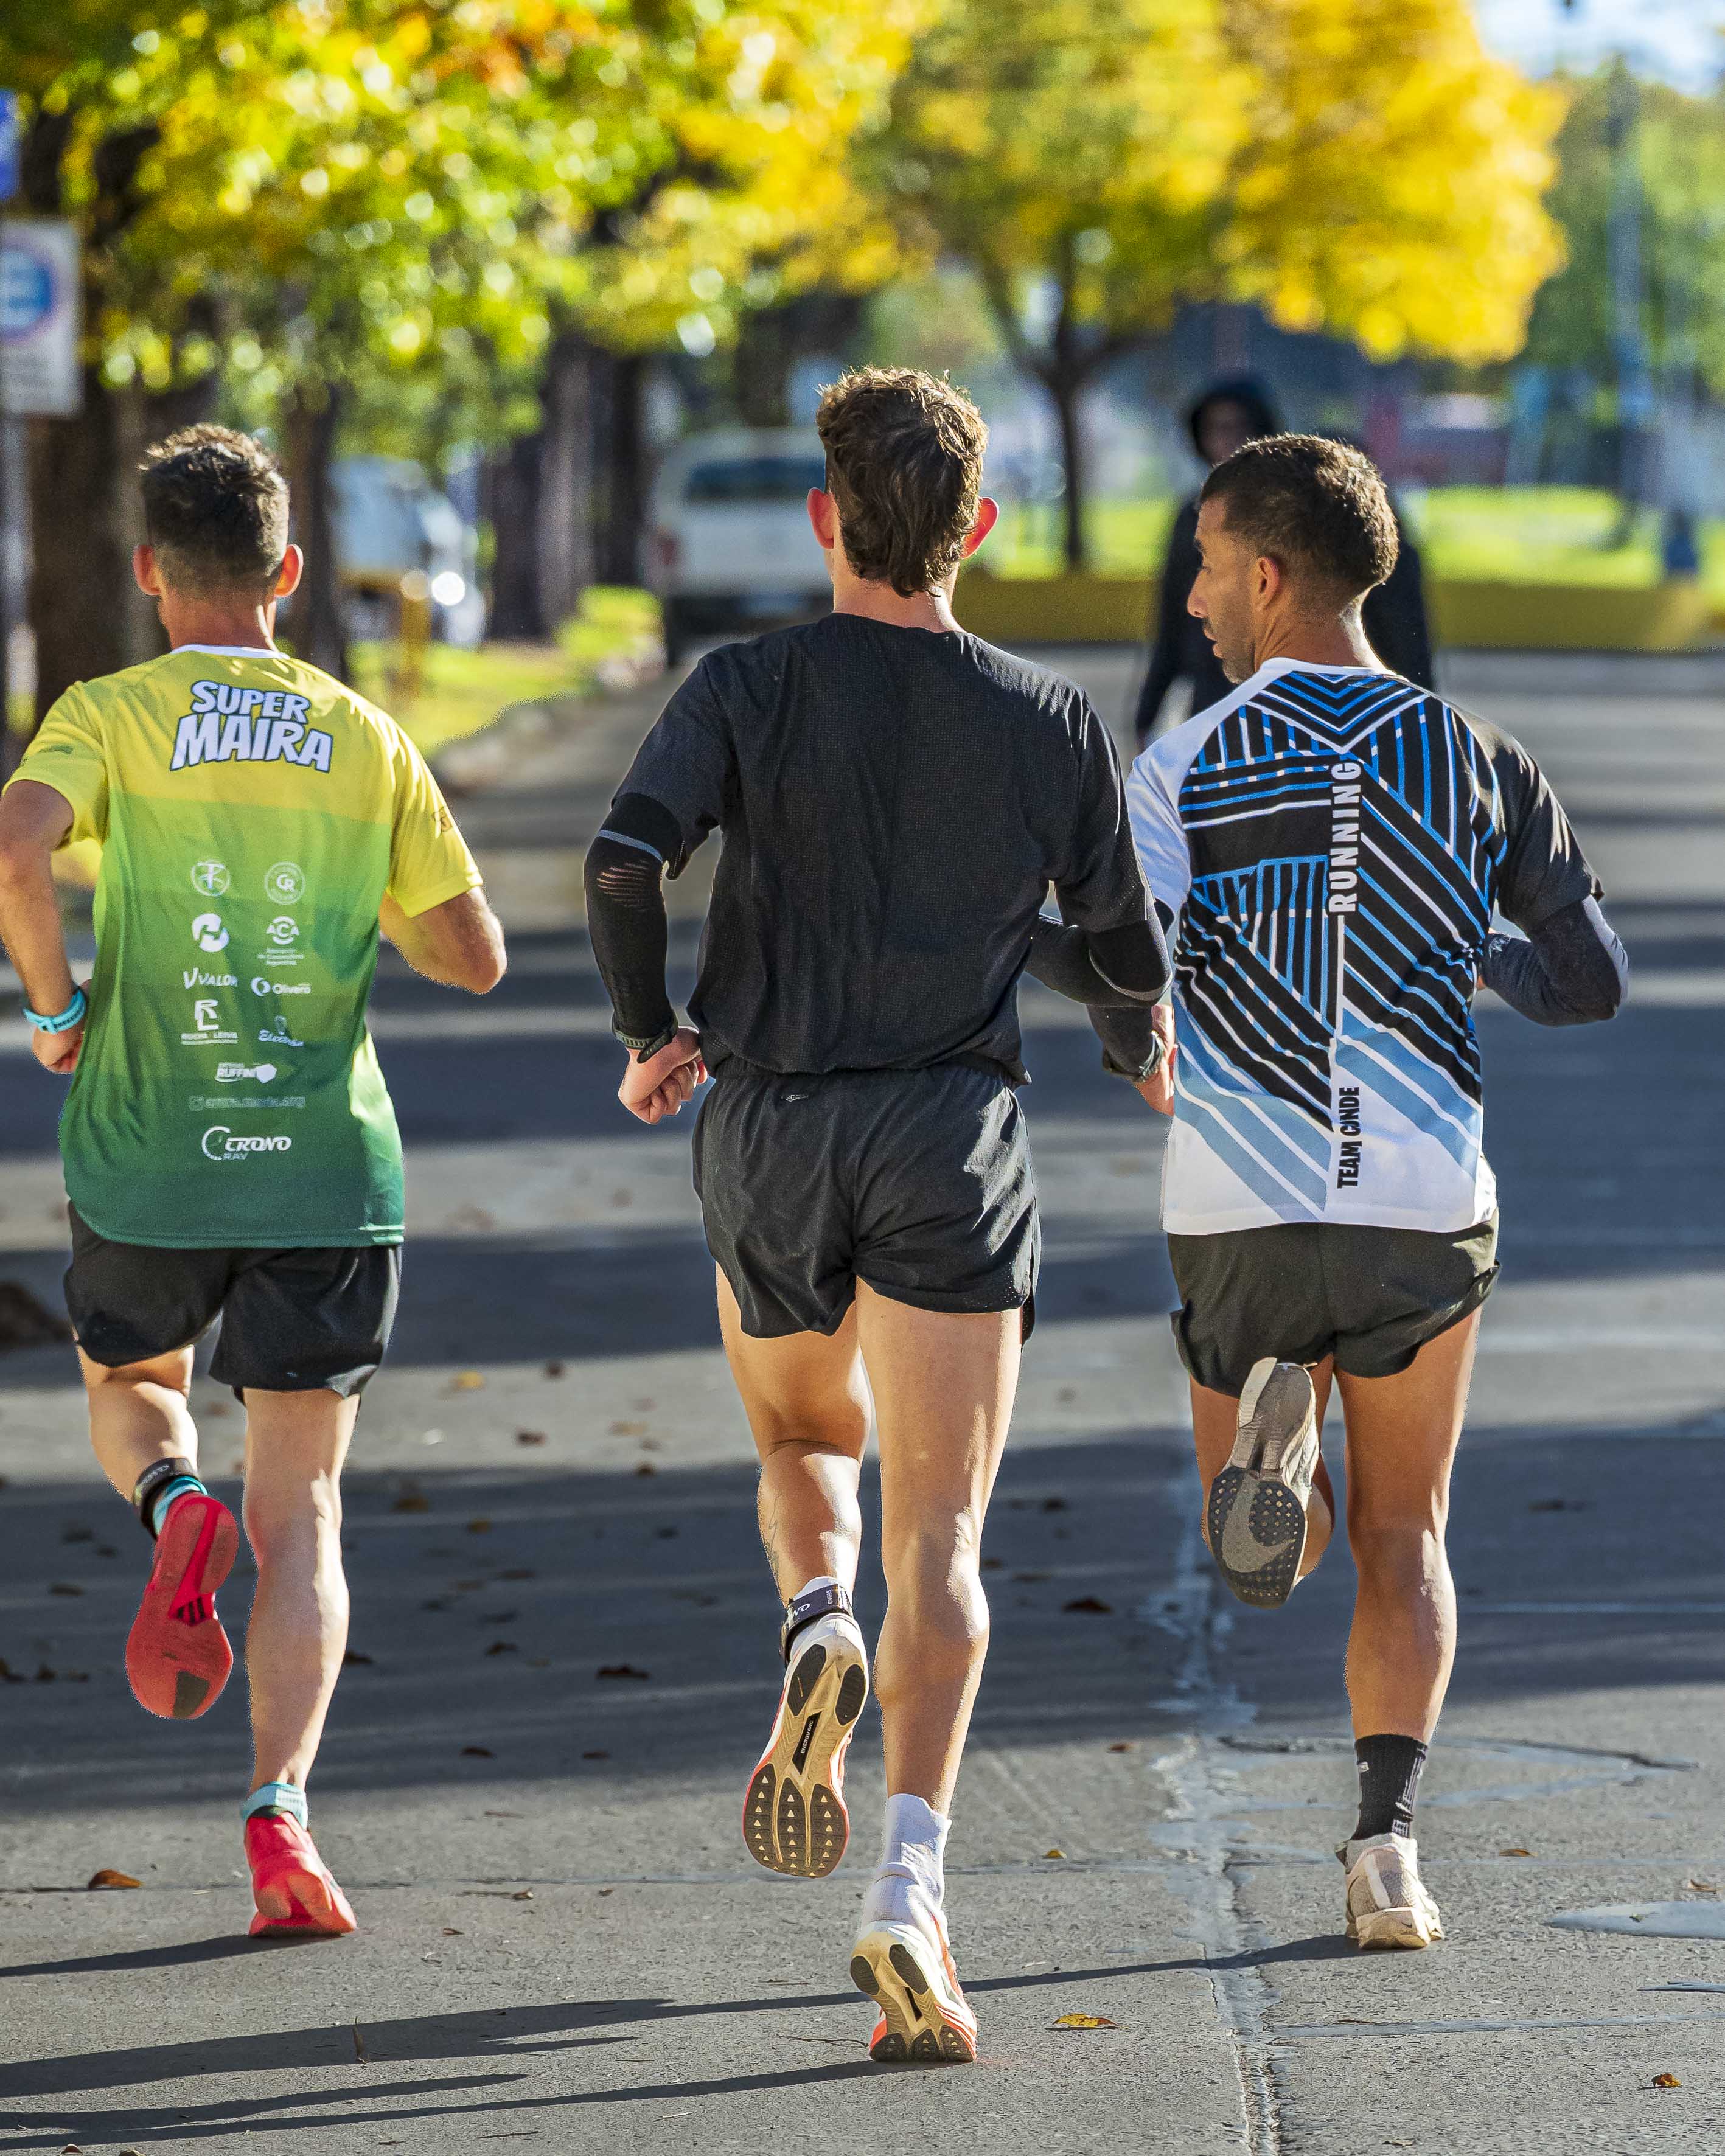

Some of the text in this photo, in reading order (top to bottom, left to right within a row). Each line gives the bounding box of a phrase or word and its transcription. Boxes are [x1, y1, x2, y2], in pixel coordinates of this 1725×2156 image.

[190, 679, 313, 725] SUPER
[169, 712, 334, 773] MAIRA
[1328, 762, 1362, 913] RUNNING
[225, 1136, 293, 1152] CRONO
[1337, 1141, 1362, 1189] TEAM
[800, 1731, 810, 1754] ENERGY
